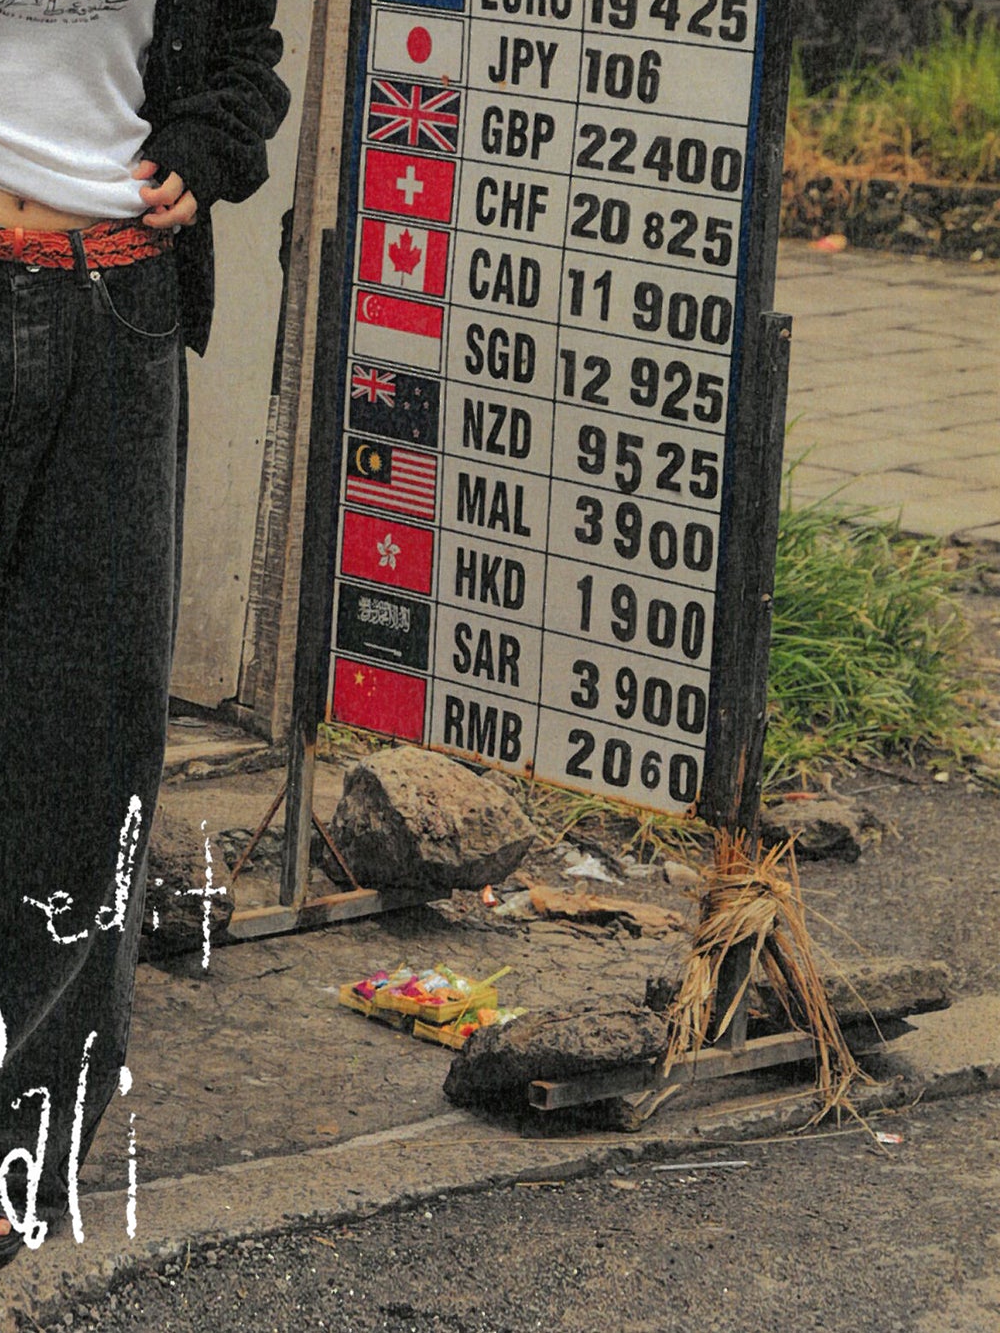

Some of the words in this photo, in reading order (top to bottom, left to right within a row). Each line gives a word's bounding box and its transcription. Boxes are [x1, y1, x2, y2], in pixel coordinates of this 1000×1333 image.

[488, 36, 559, 89] JPY
[585, 47, 662, 104] 106
[481, 105, 555, 161] GBP
[475, 176, 549, 233] CHF
[469, 248, 541, 309] CAD
[465, 323, 536, 385] SGD
[463, 398, 532, 460] NZD
[457, 473, 531, 537] MAL
[456, 547, 526, 611] HKD
[453, 621, 521, 687] SAR
[444, 695, 522, 763] RMB
